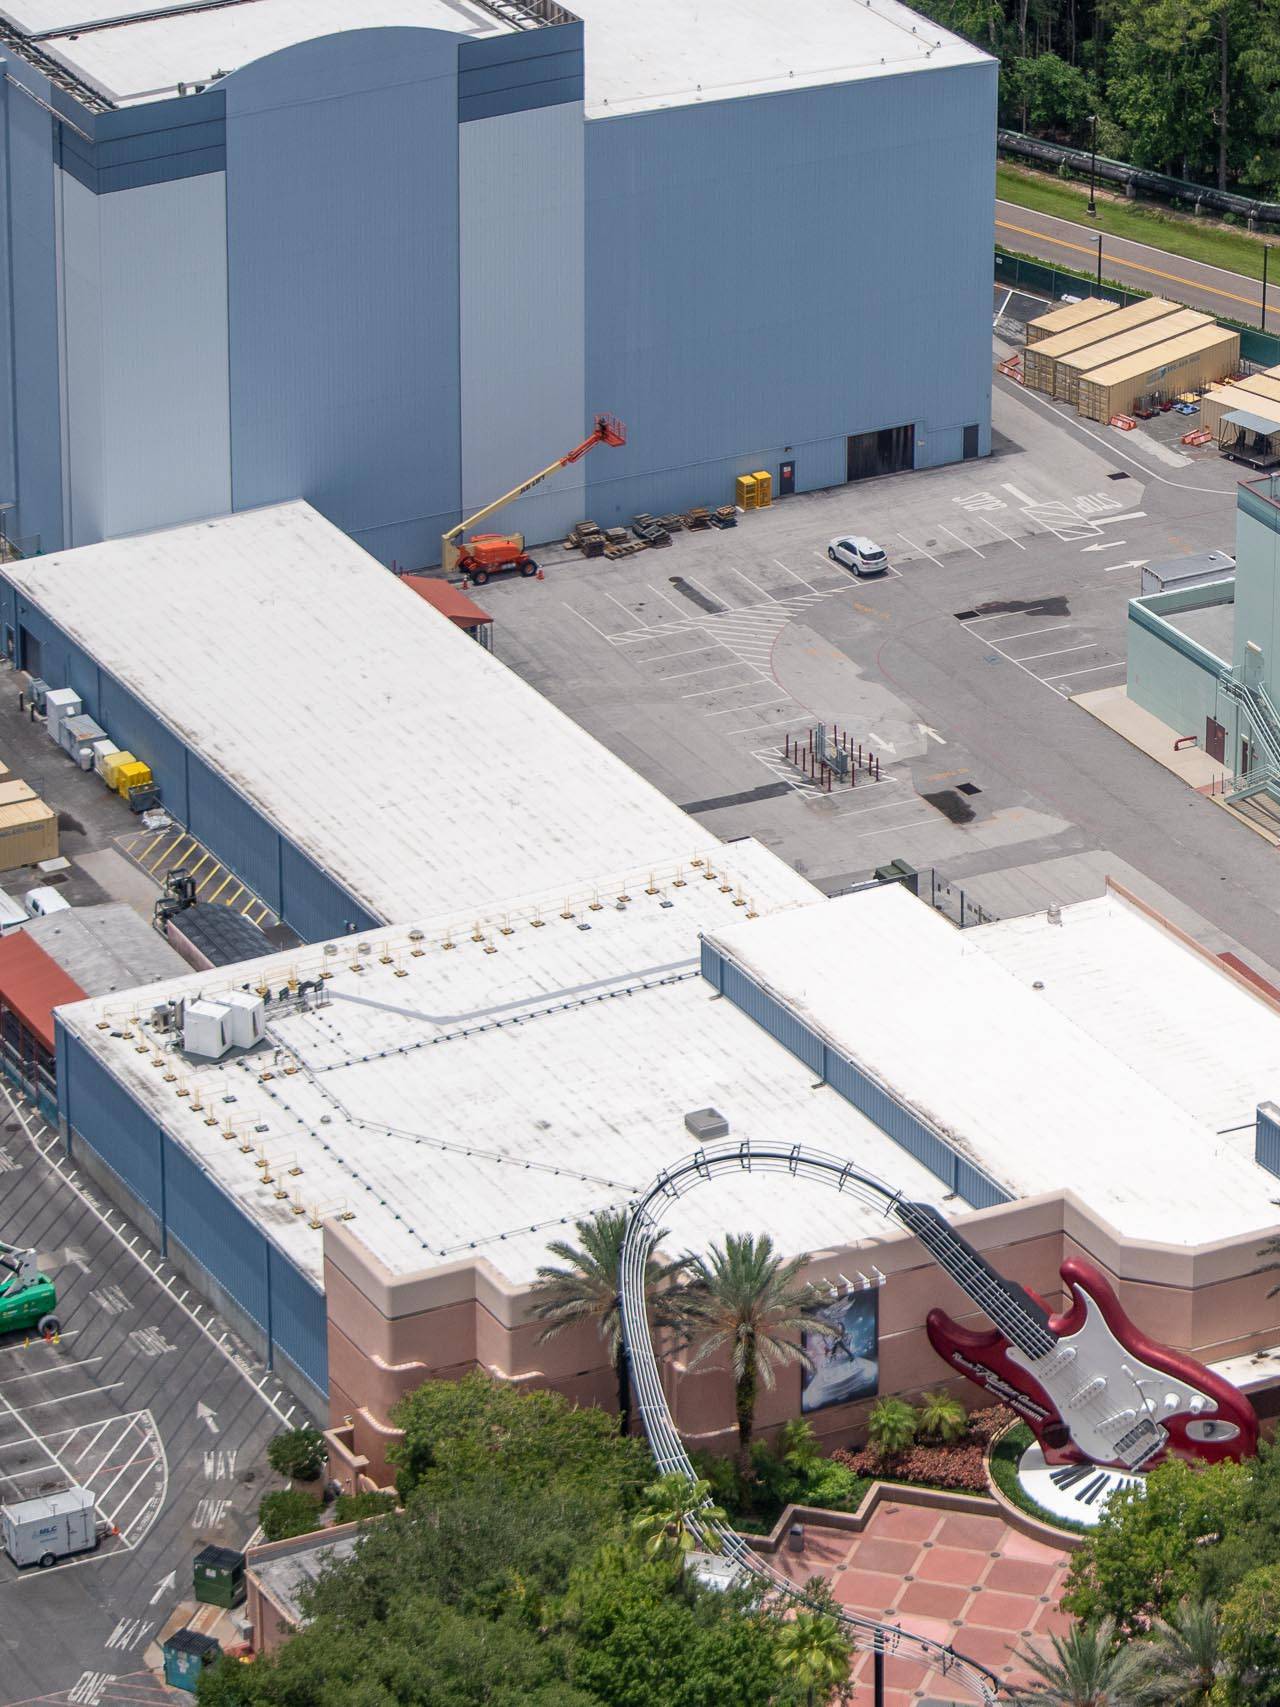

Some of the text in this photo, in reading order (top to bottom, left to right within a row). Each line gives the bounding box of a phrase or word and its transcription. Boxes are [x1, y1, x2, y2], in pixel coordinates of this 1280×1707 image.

[952, 491, 1008, 512] STOP
[1072, 492, 1123, 513] STOP
[128, 1325, 178, 1356] ONE
[203, 1450, 238, 1480] WAY
[192, 1499, 232, 1529] ONE
[105, 1617, 155, 1651] WAY
[68, 1670, 117, 1706] ONE
